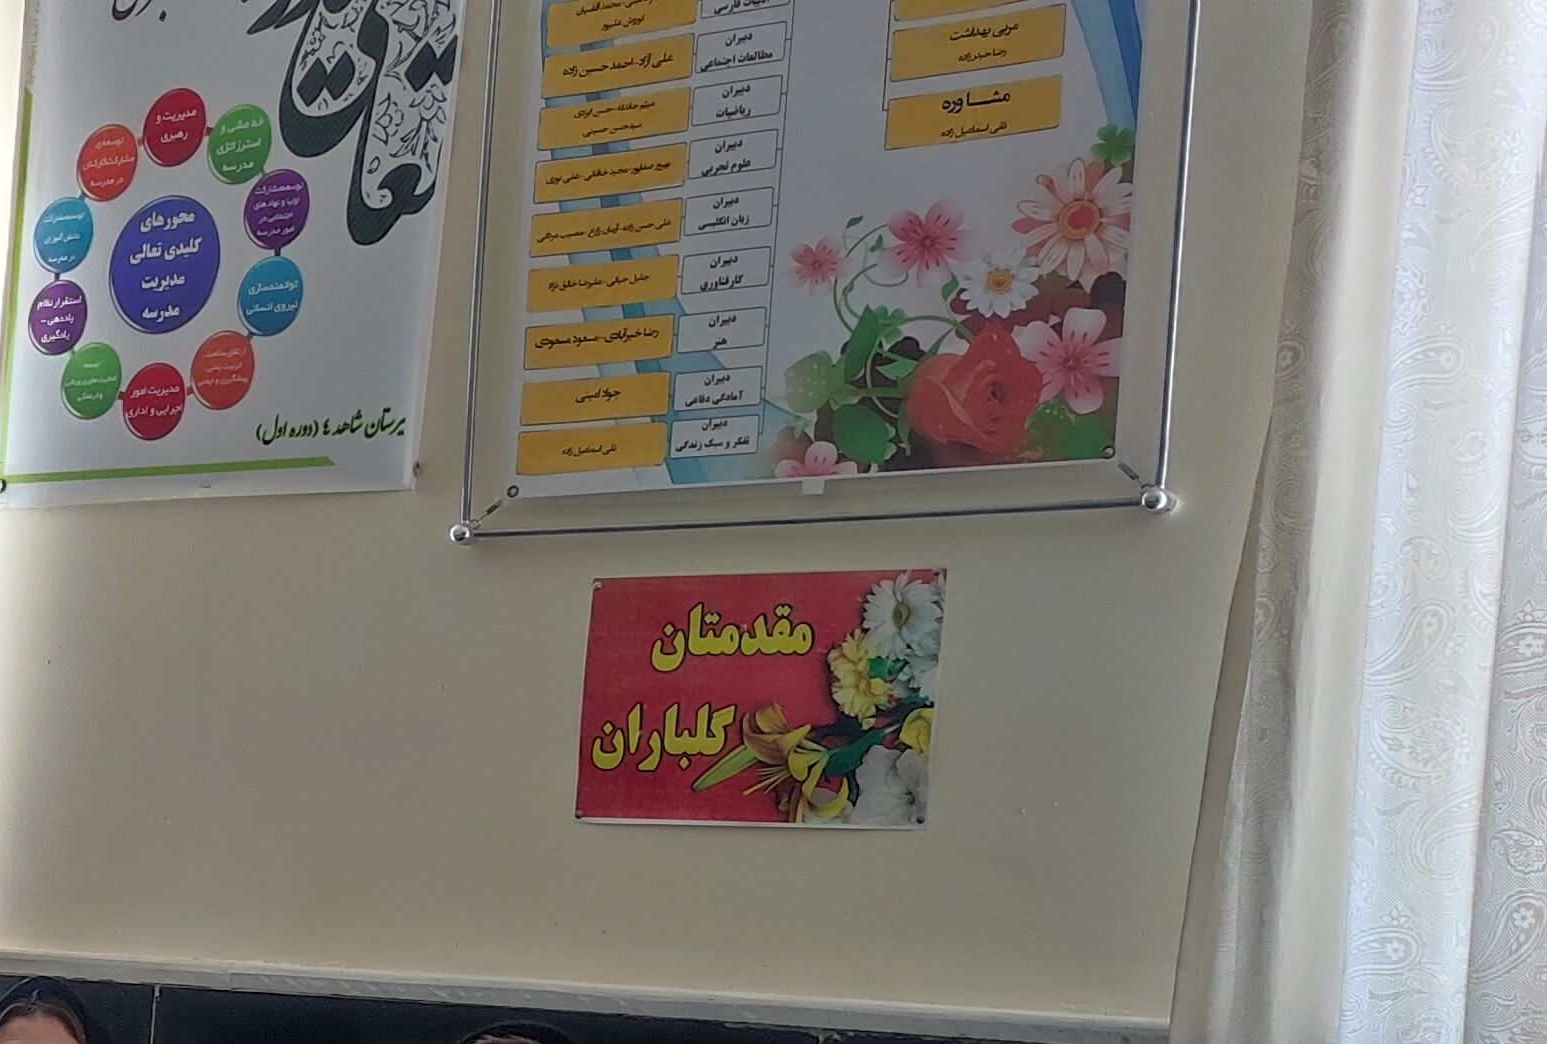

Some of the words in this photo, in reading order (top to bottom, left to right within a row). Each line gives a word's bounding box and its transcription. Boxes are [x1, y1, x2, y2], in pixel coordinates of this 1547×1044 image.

[949, 27, 991, 41] بهداشت
[992, 23, 1019, 38] مربی
[725, 33, 753, 47] دبیران
[652, 52, 674, 69] علی
[700, 54, 736, 72] اجتماعی
[737, 50, 773, 63] مطالعات
[563, 65, 578, 77] زاده
[579, 64, 609, 78] حسین
[721, 83, 751, 100] دبیران
[162, 108, 197, 122] مدیریت
[715, 106, 751, 119] ریاضیات
[160, 131, 188, 143] رهبری
[582, 127, 609, 138] حسینی
[940, 128, 955, 138] زاده
[955, 123, 989, 139] اسماعیل
[714, 139, 743, 153] دبیران
[222, 160, 254, 173] مدرسه
[701, 160, 728, 177] تجربی
[729, 159, 751, 171] علوم
[712, 195, 740, 209] دبیران
[140, 211, 196, 233] محورهای
[655, 218, 672, 230] علی
[698, 216, 730, 231] انگلیسی
[731, 214, 750, 227] زبان
[129, 242, 164, 265] تعالی
[164, 236, 203, 261] کلیدی
[710, 255, 739, 269] دبیران
[141, 273, 186, 292] مدیریت
[142, 304, 180, 322] مدرسه
[245, 302, 273, 316] انسانی
[274, 302, 298, 313] نیروی
[708, 315, 737, 328] دبیران
[643, 327, 660, 339] رضا
[535, 337, 572, 350] مسعودی
[712, 338, 727, 350] هنر
[703, 373, 731, 386] دبیران
[148, 386, 180, 396] مدیریت
[601, 387, 621, 402] جواد
[712, 390, 744, 405] آمادگی
[684, 394, 711, 408] دفاعی
[256, 413, 288, 445] اول)
[288, 419, 319, 438] (دوره
[332, 409, 363, 436] شاهد
[701, 418, 728, 431] دبیران
[675, 440, 703, 453] زندگی
[704, 438, 724, 449] سبک
[731, 435, 750, 449] تفکر
[651, 601, 814, 673] مقدمتان
[590, 701, 738, 773] گلباران
